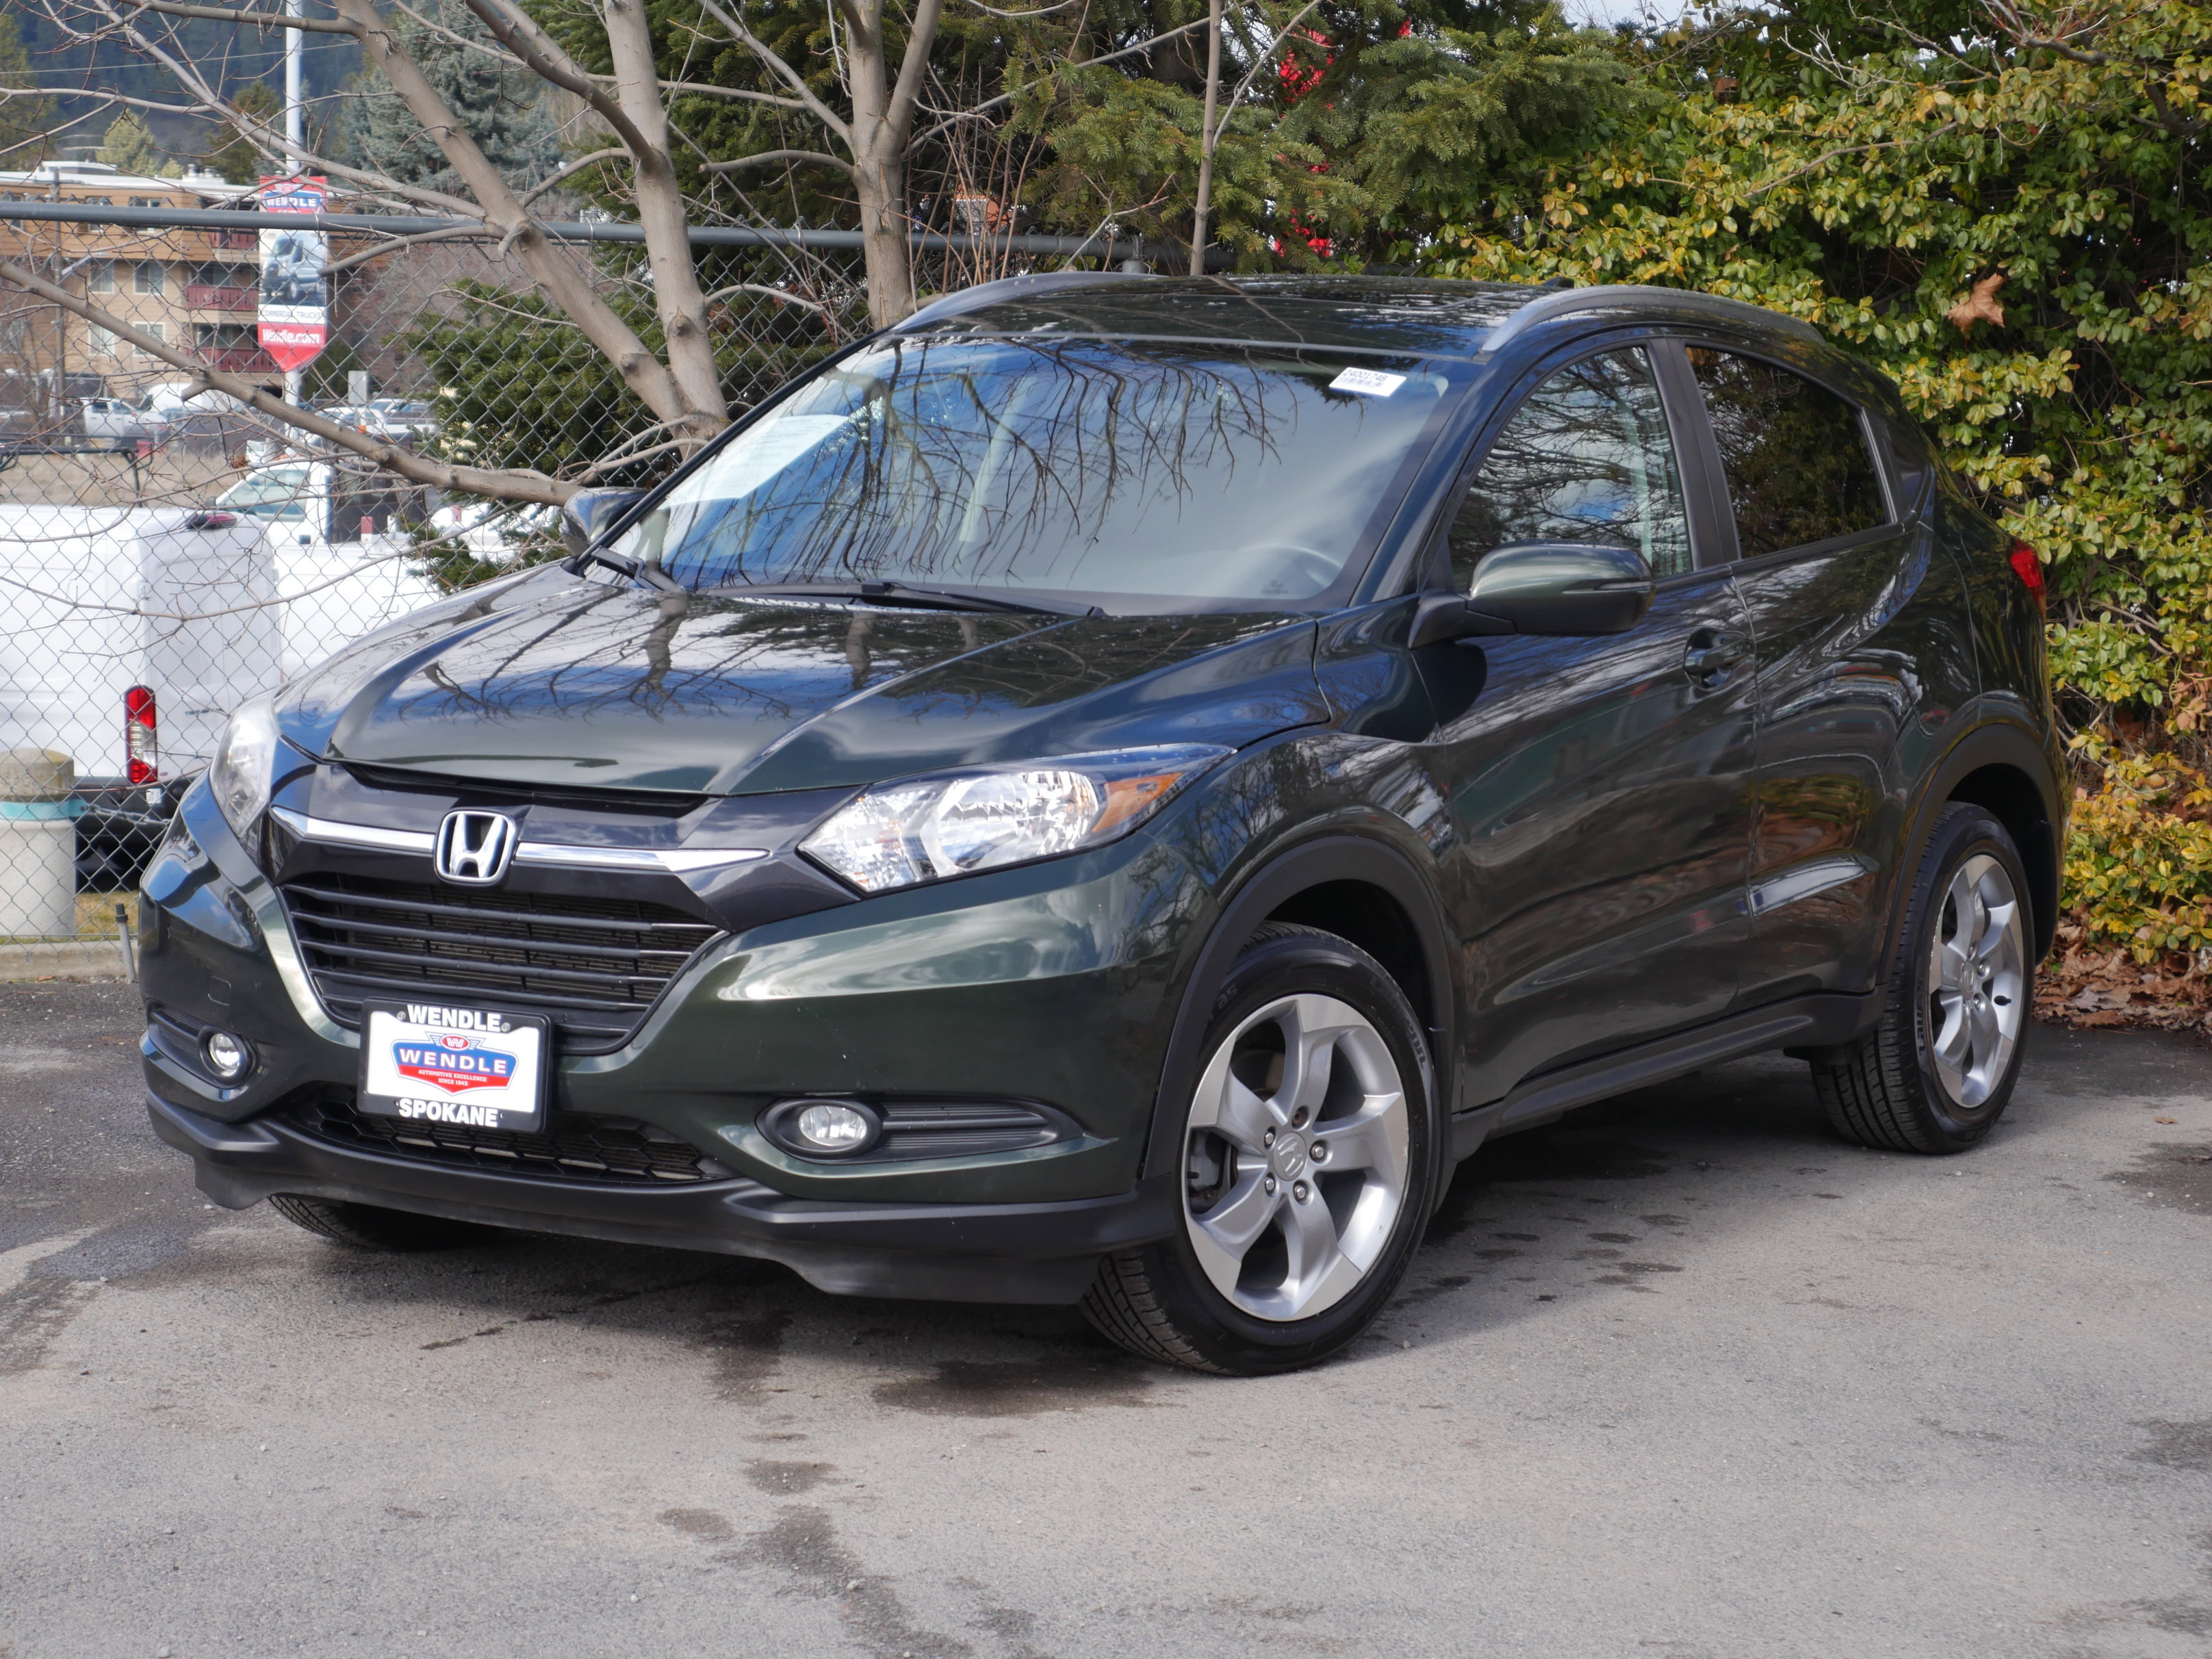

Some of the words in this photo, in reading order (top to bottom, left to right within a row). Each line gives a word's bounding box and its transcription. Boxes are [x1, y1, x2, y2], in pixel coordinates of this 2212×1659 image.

[261, 309, 293, 318] COMMERCIA
[296, 311, 322, 319] TRUCKS
[262, 329, 320, 344] Wendle.com
[407, 1004, 502, 1033] WENDLE
[399, 1049, 506, 1075] WENDLE
[418, 1069, 452, 1078] AUTOMOTIVE
[453, 1073, 487, 1083] EXCELLENCE
[398, 1098, 498, 1127] SPOKANE
